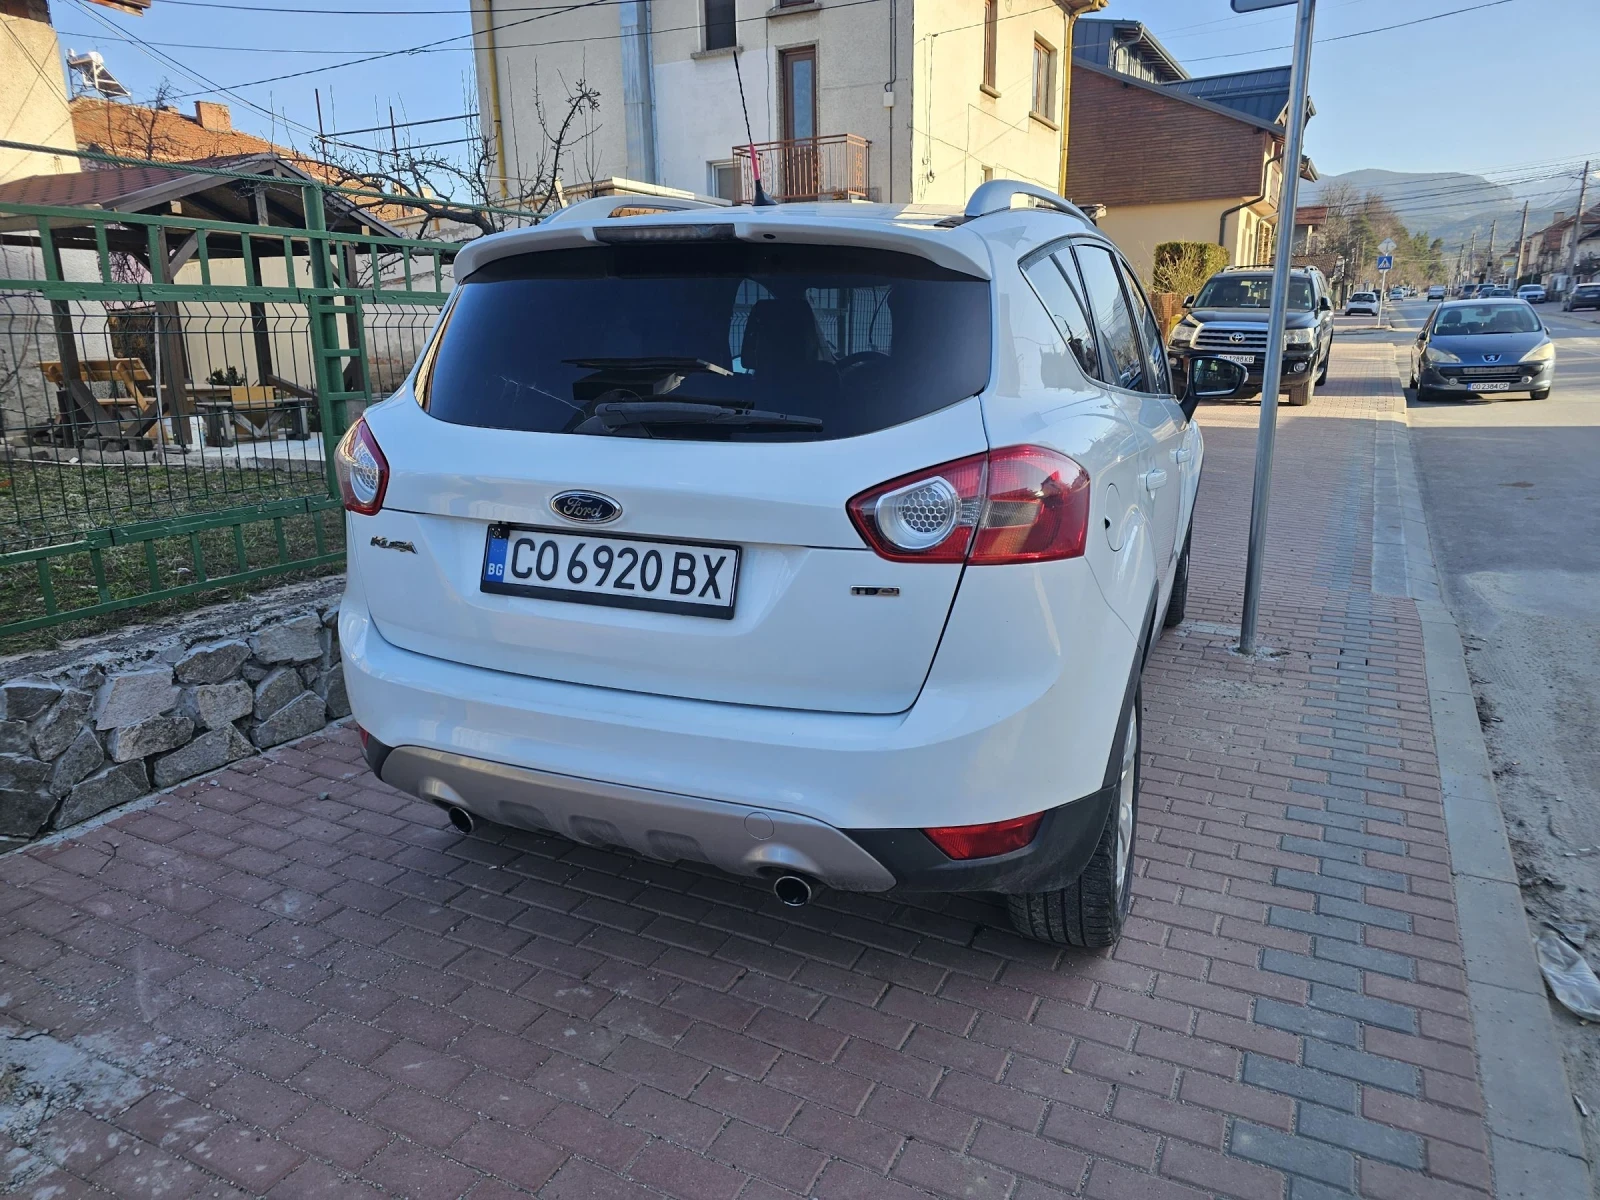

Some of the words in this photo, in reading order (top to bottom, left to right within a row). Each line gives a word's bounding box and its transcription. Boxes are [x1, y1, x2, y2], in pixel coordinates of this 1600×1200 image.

[563, 496, 603, 517] Ford
[488, 562, 504, 576] BG
[511, 538, 559, 581] CO
[567, 542, 663, 592] 6920
[670, 551, 727, 600] BX
